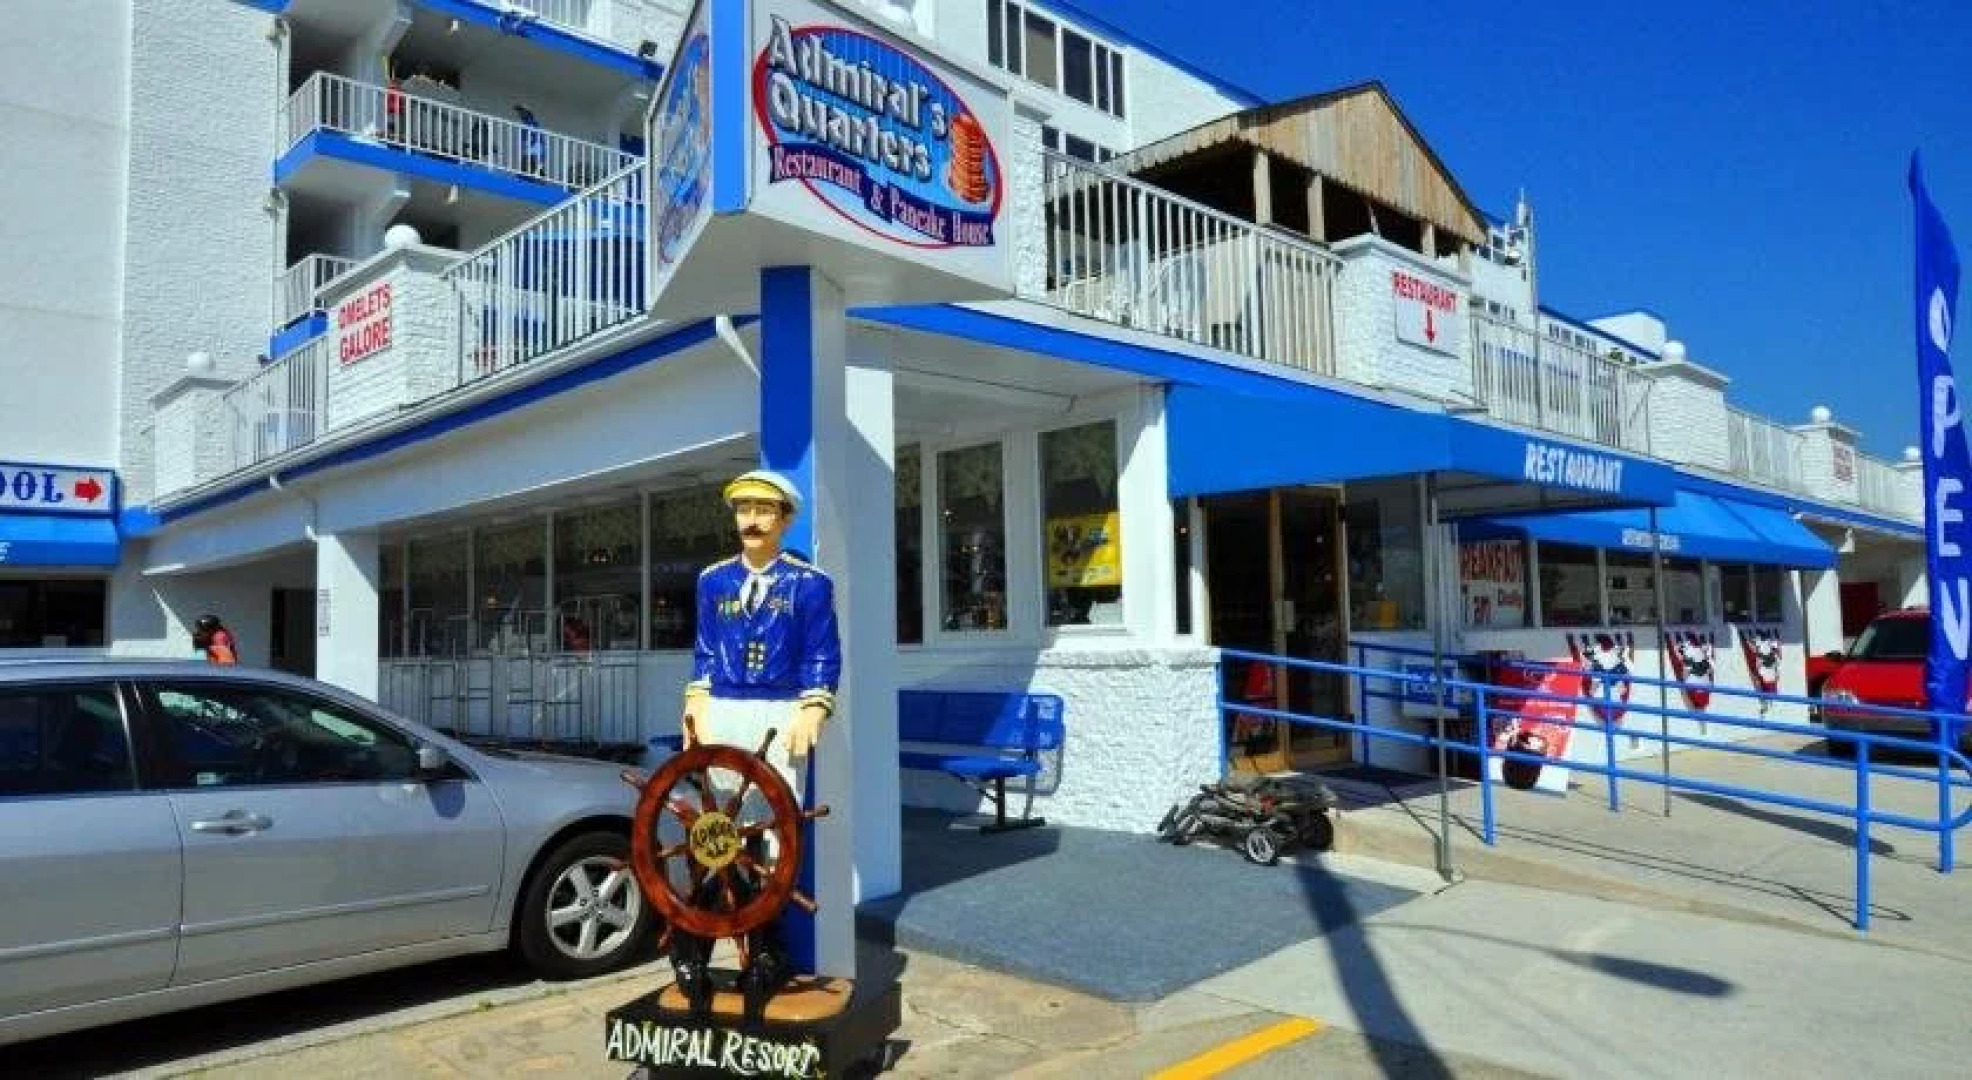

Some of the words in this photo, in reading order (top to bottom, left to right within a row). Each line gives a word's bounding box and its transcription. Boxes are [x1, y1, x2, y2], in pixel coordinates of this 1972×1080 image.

[769, 13, 948, 138] Admiral's
[769, 71, 933, 181] Quarters
[773, 147, 863, 194] Restaurant
[870, 187, 882, 211] &
[890, 189, 947, 241] Pancake
[952, 212, 991, 246] House
[338, 282, 392, 330] OMELETS
[1391, 271, 1458, 312] RESTAURANT
[339, 317, 392, 364] GALORE
[0, 471, 64, 503] OL
[1525, 441, 1621, 494] RESTAURANT
[606, 1018, 717, 1067] ADMIRAL
[720, 1031, 820, 1078] RESORT
